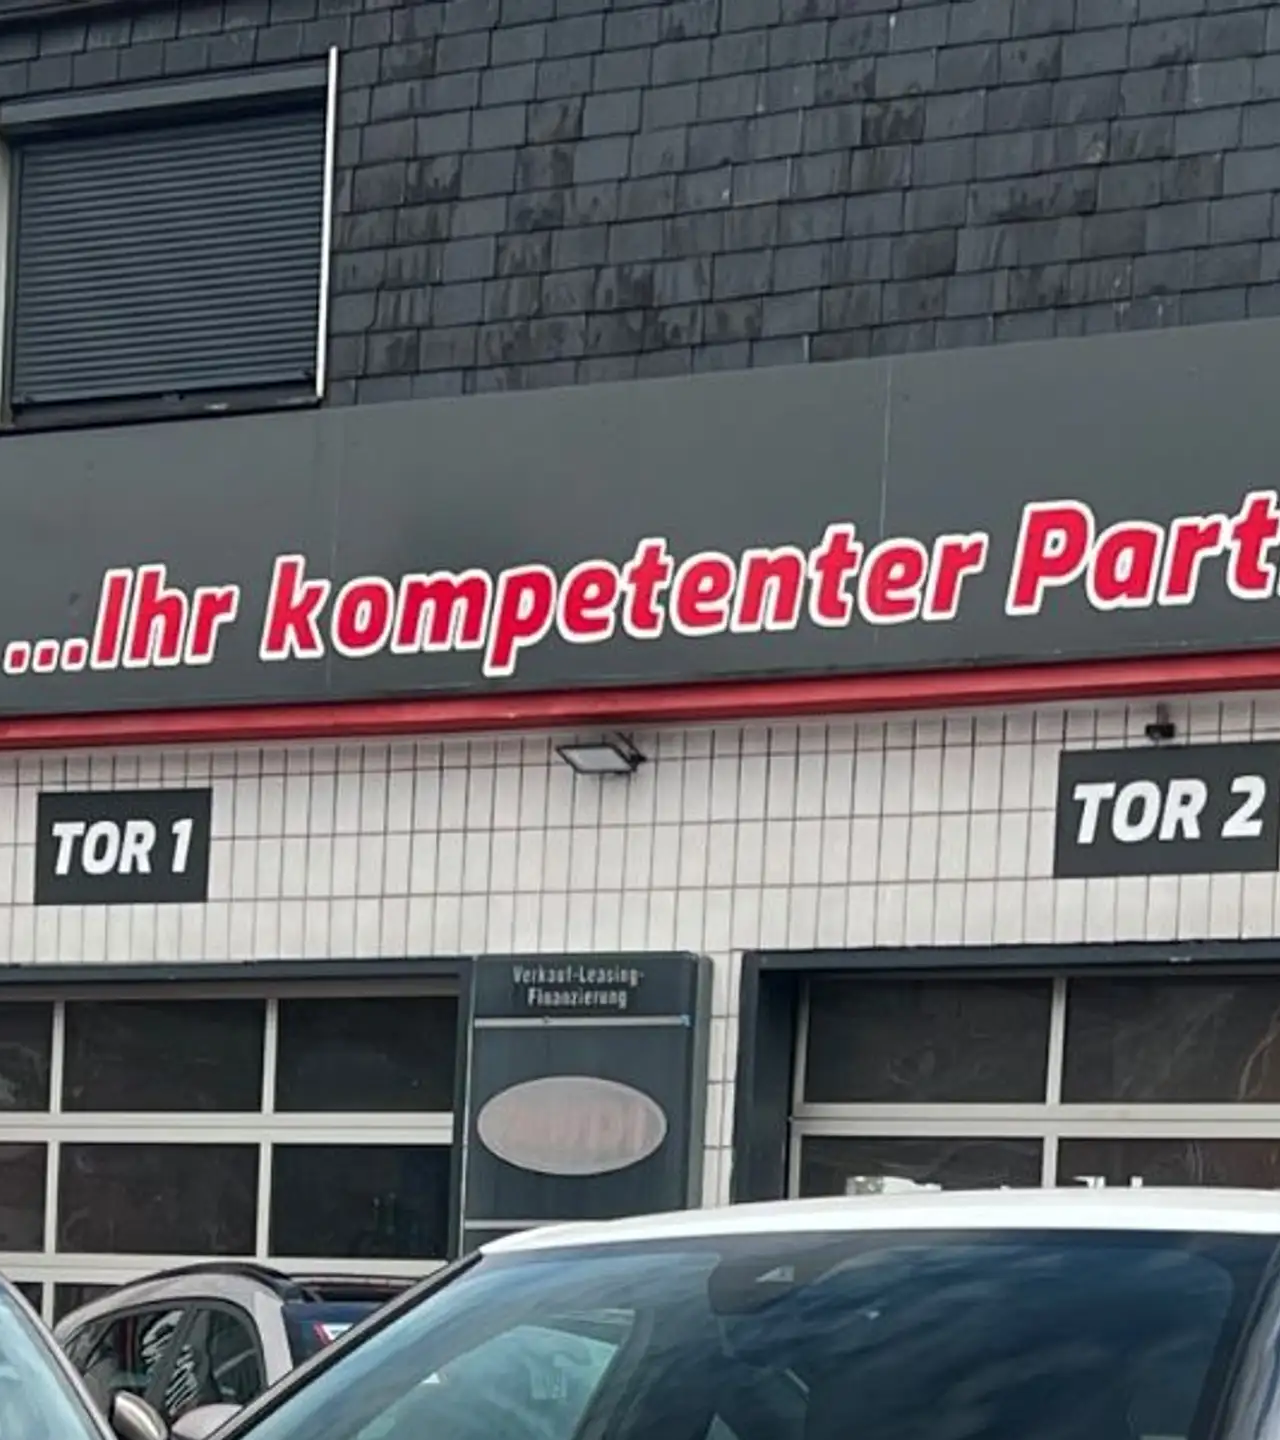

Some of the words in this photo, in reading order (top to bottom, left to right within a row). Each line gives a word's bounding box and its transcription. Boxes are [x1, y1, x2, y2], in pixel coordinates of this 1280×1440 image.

[3, 563, 239, 675] ...Ihr
[258, 522, 988, 678] kompetenter
[1072, 778, 1207, 844] TOR
[1221, 775, 1266, 839] 2
[51, 822, 152, 877] TOR
[168, 818, 194, 873] 1
[527, 988, 628, 1009] Finanzierung
